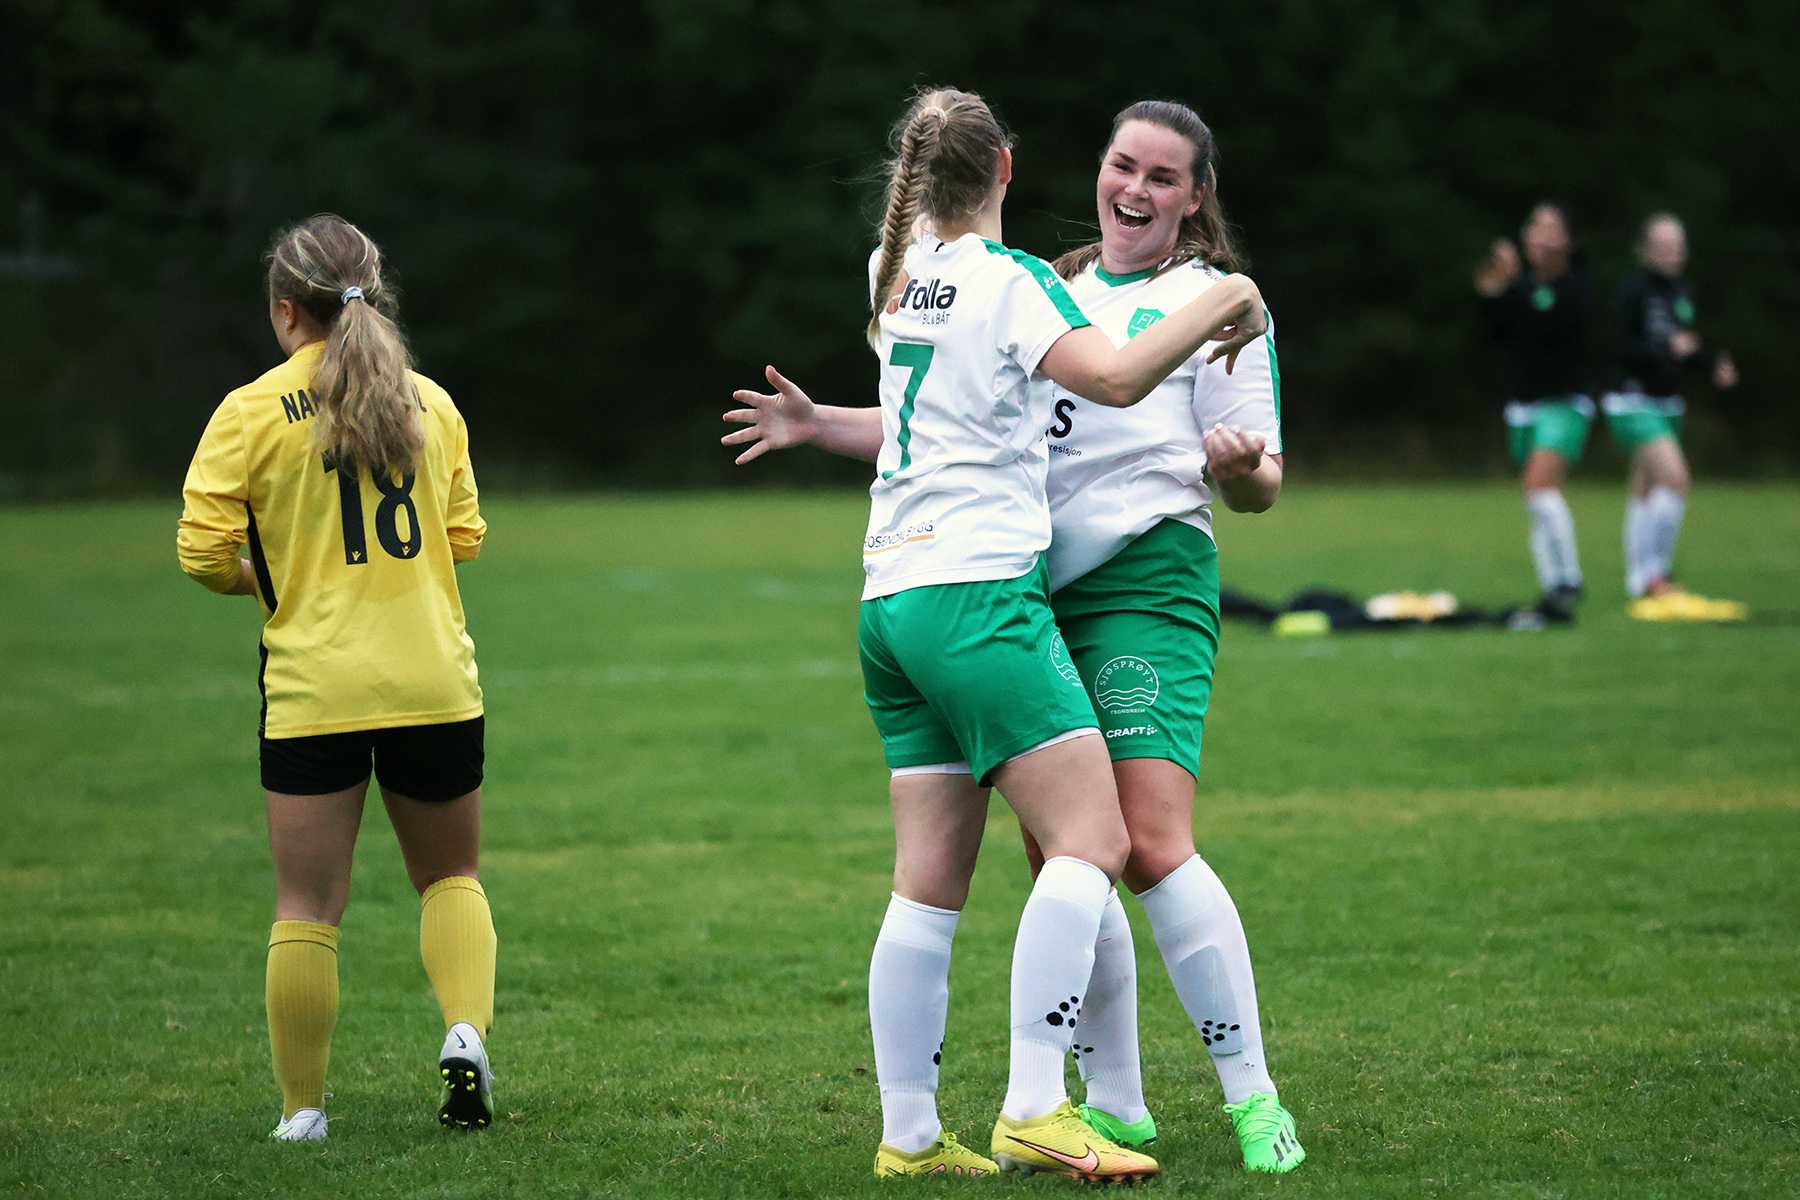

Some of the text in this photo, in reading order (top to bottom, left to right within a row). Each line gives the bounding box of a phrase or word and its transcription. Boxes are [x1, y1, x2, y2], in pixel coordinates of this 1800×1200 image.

[900, 279, 957, 310] folla
[882, 342, 934, 481] 7
[1045, 399, 1077, 438] S
[321, 445, 422, 565] 18
[1100, 660, 1154, 686] SJØSPRØYT
[1106, 726, 1146, 738] CRAFT
